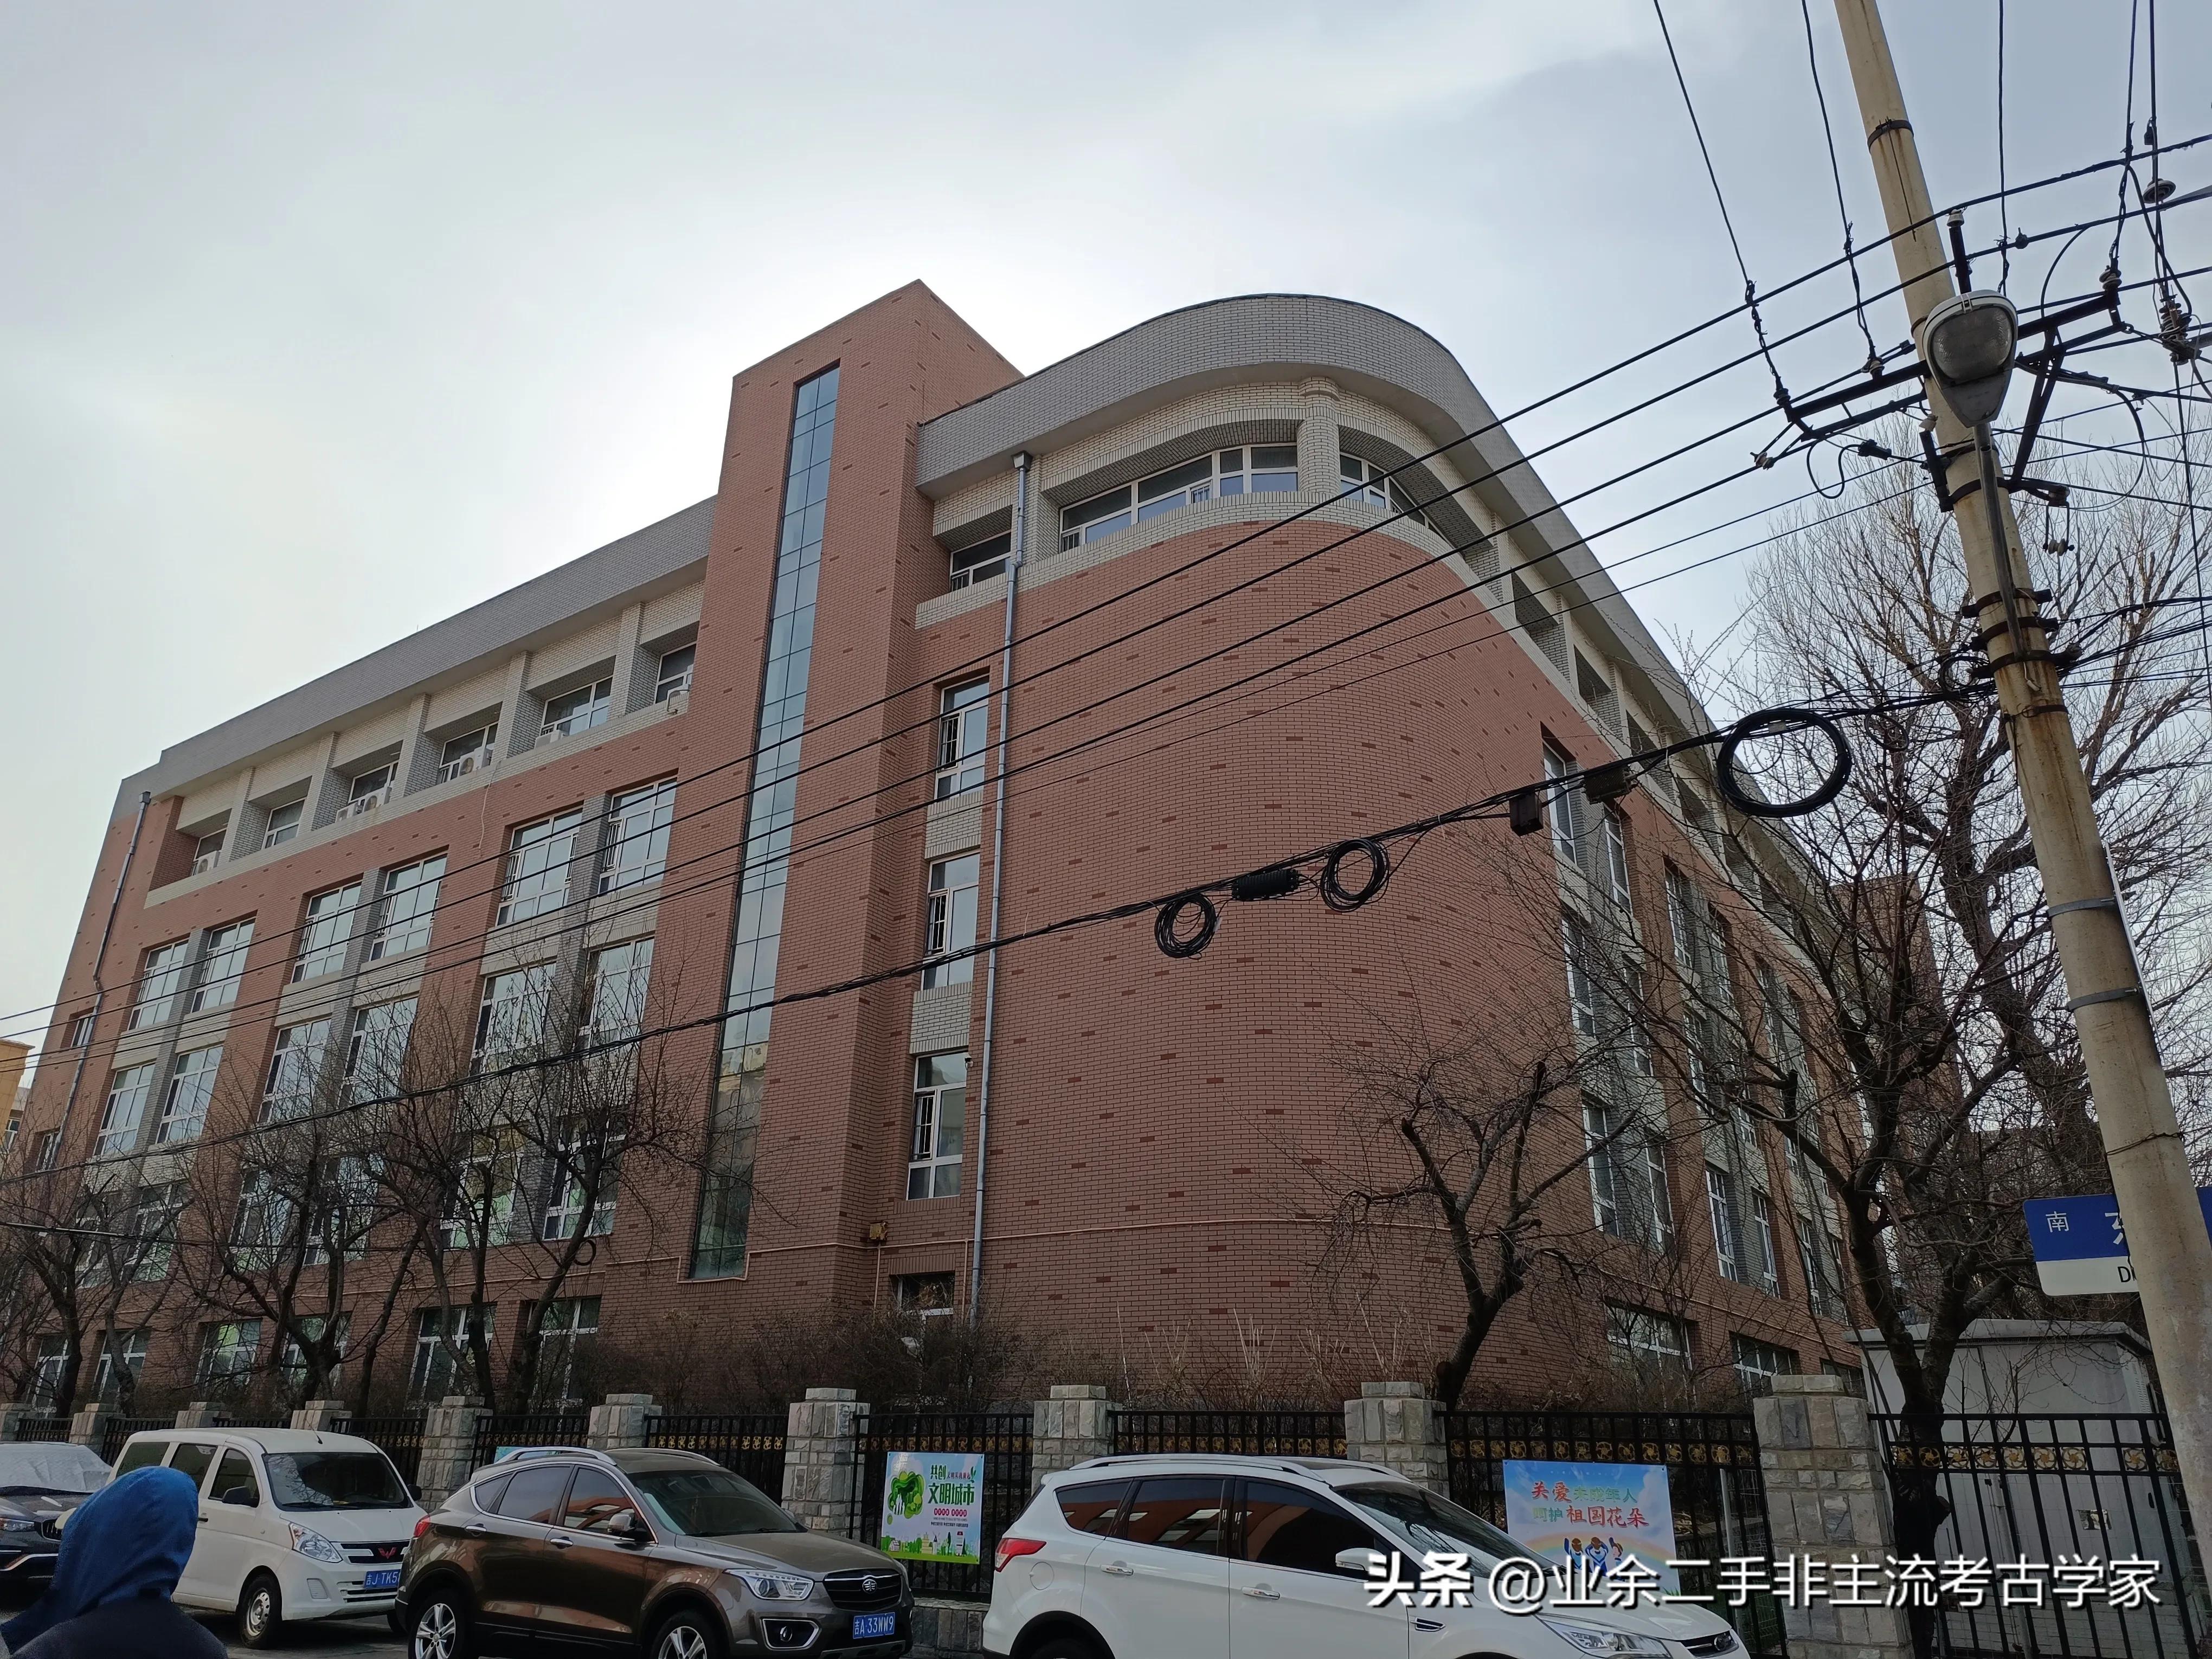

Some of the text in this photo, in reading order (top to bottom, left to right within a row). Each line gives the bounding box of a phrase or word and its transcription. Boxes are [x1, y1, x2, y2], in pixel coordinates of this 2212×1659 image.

[2046, 1211, 2069, 1232] 南
[930, 1464, 946, 1480] 共创
[928, 1482, 975, 1505] 文明城市
[1531, 1481, 1638, 1503] 关爱未成年人
[1532, 1505, 1649, 1529] 呵护祖国花朵
[366, 1571, 400, 1586] 吉J·TK5
